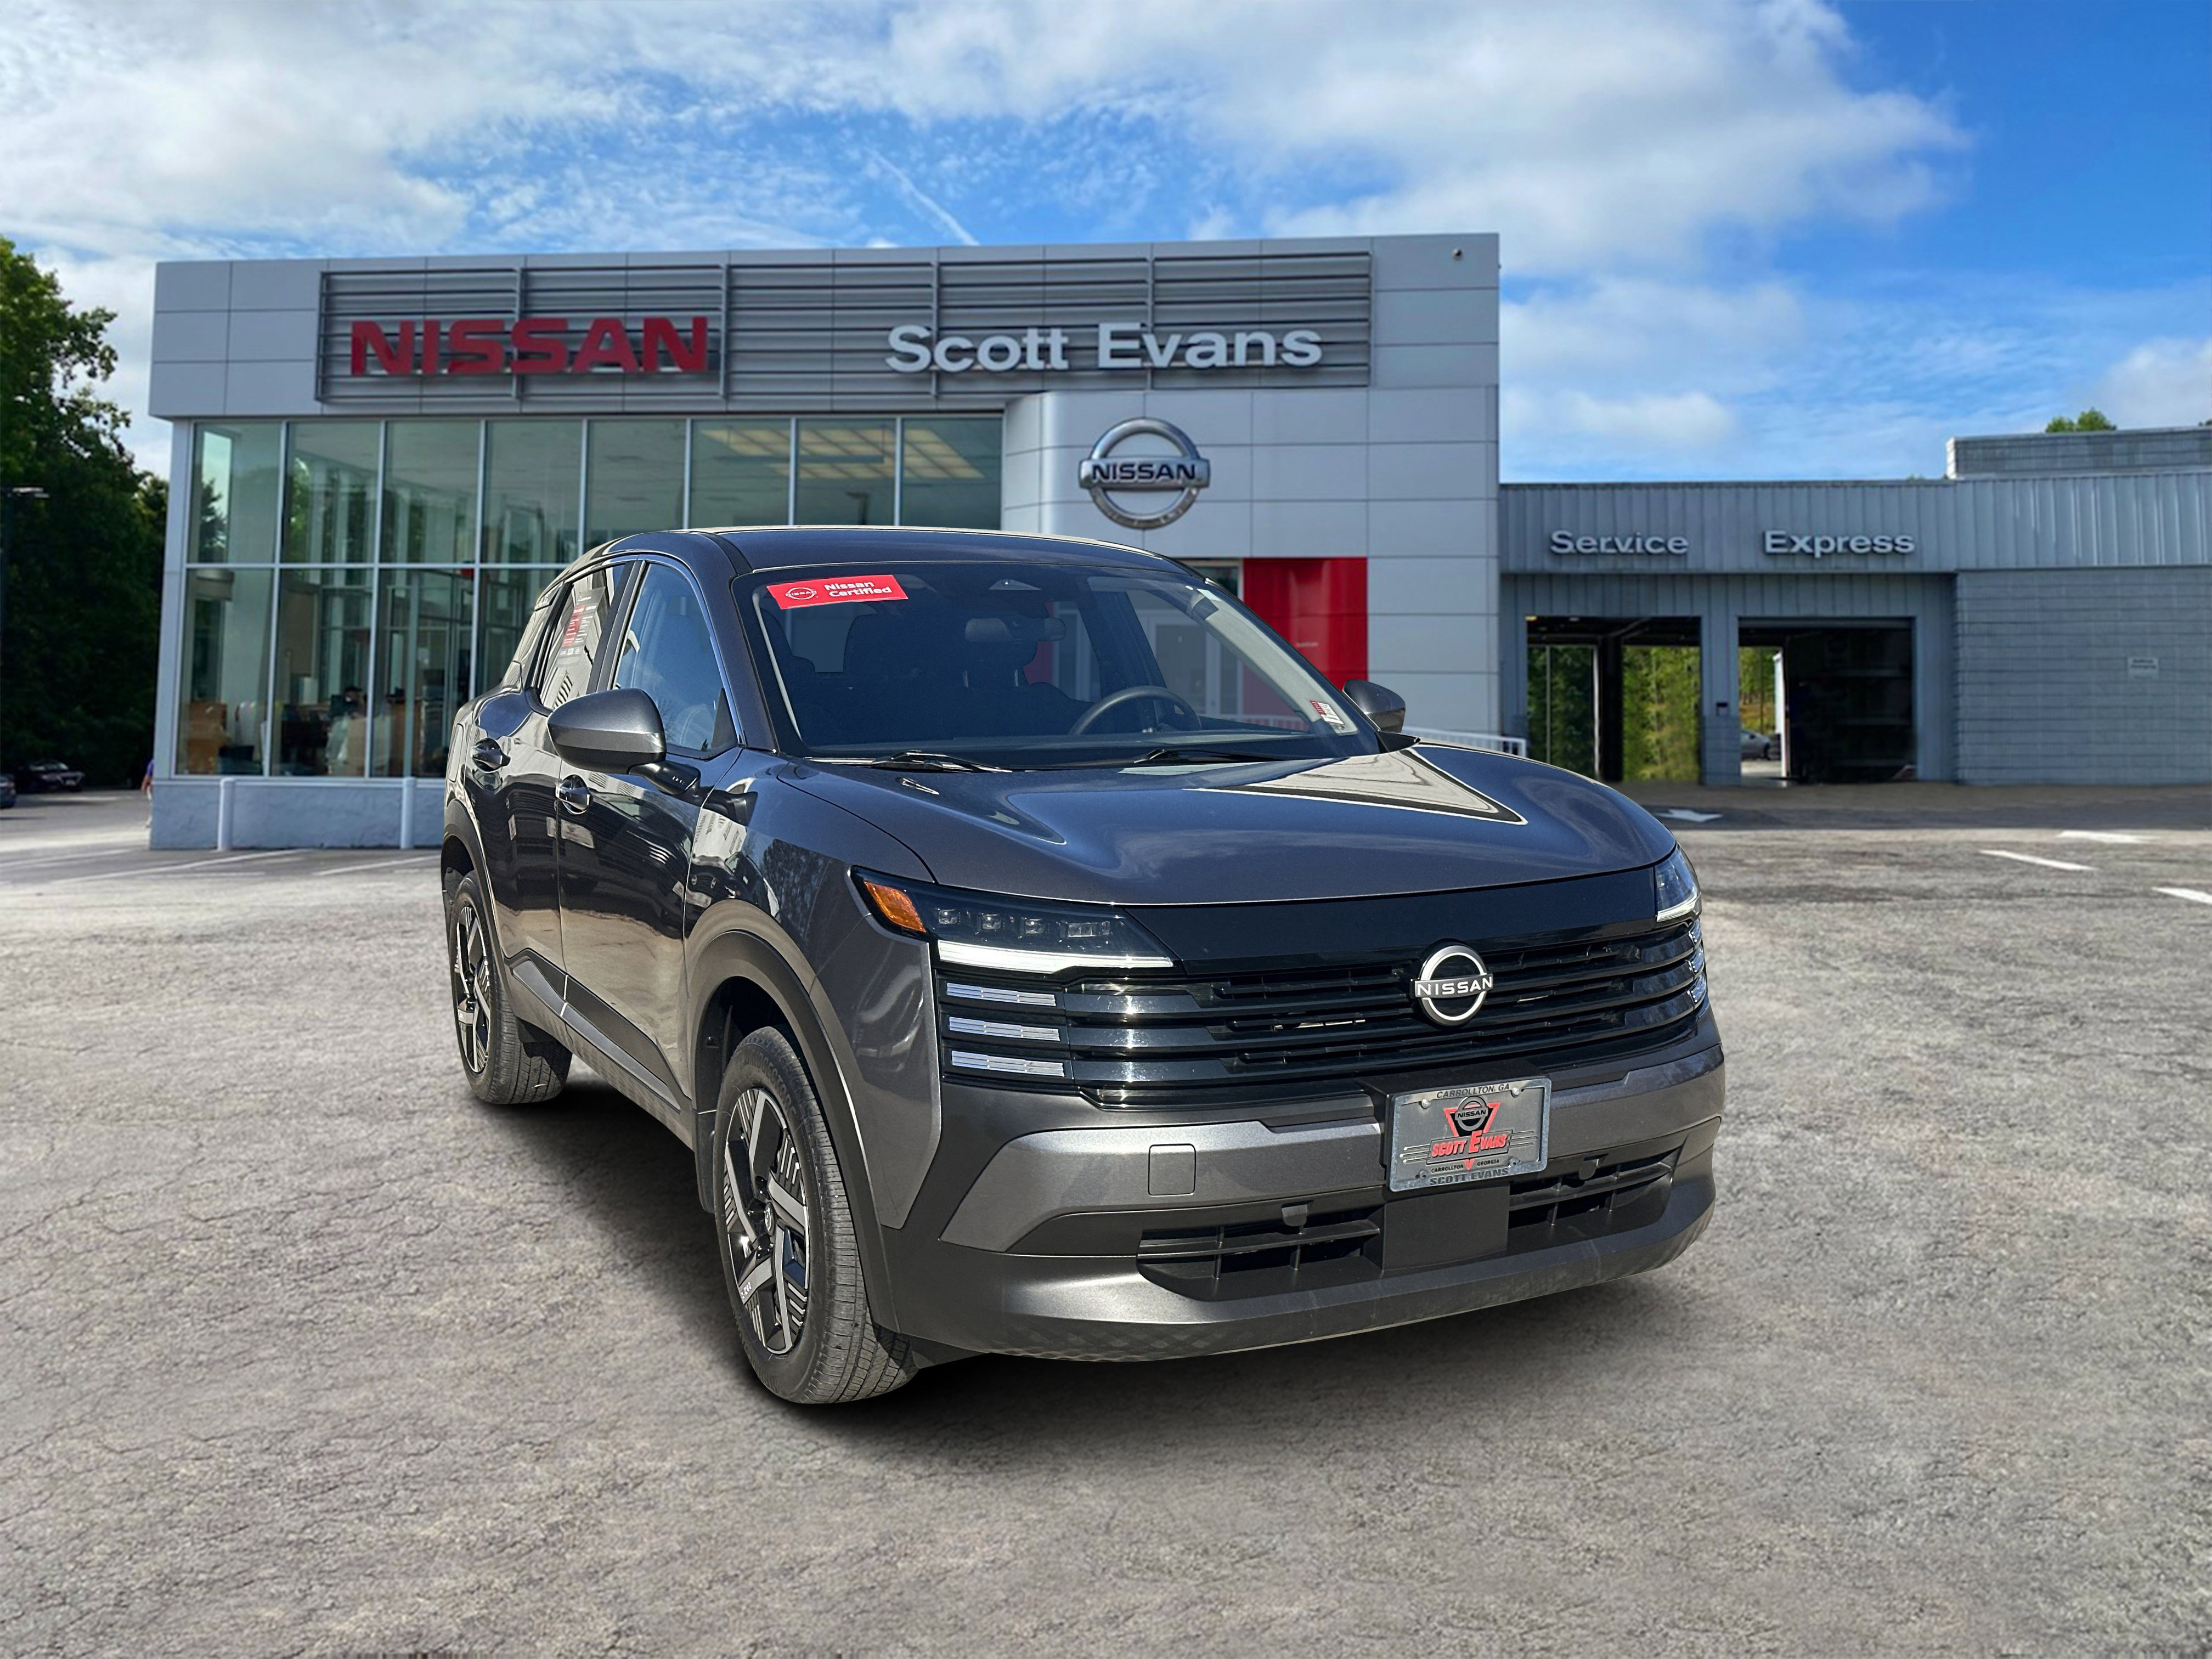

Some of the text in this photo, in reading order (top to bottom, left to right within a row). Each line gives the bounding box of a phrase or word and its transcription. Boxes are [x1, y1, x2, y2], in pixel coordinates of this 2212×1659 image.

[351, 317, 708, 375] NISSAN
[885, 322, 1324, 373] Scott Evans
[1092, 464, 1195, 480] NISSAN
[1550, 530, 1916, 558] Service Express
[824, 582, 875, 591] Nissan
[829, 586, 893, 597] Certified
[1417, 977, 1492, 996] NISSAN
[1457, 1109, 1486, 1118] NISSAN
[1431, 1130, 1508, 1158] SCOTT EVANS
[1430, 1168, 1509, 1186] SCOTT EVANS
[1431, 1164, 1464, 1173] CARROLLTON
